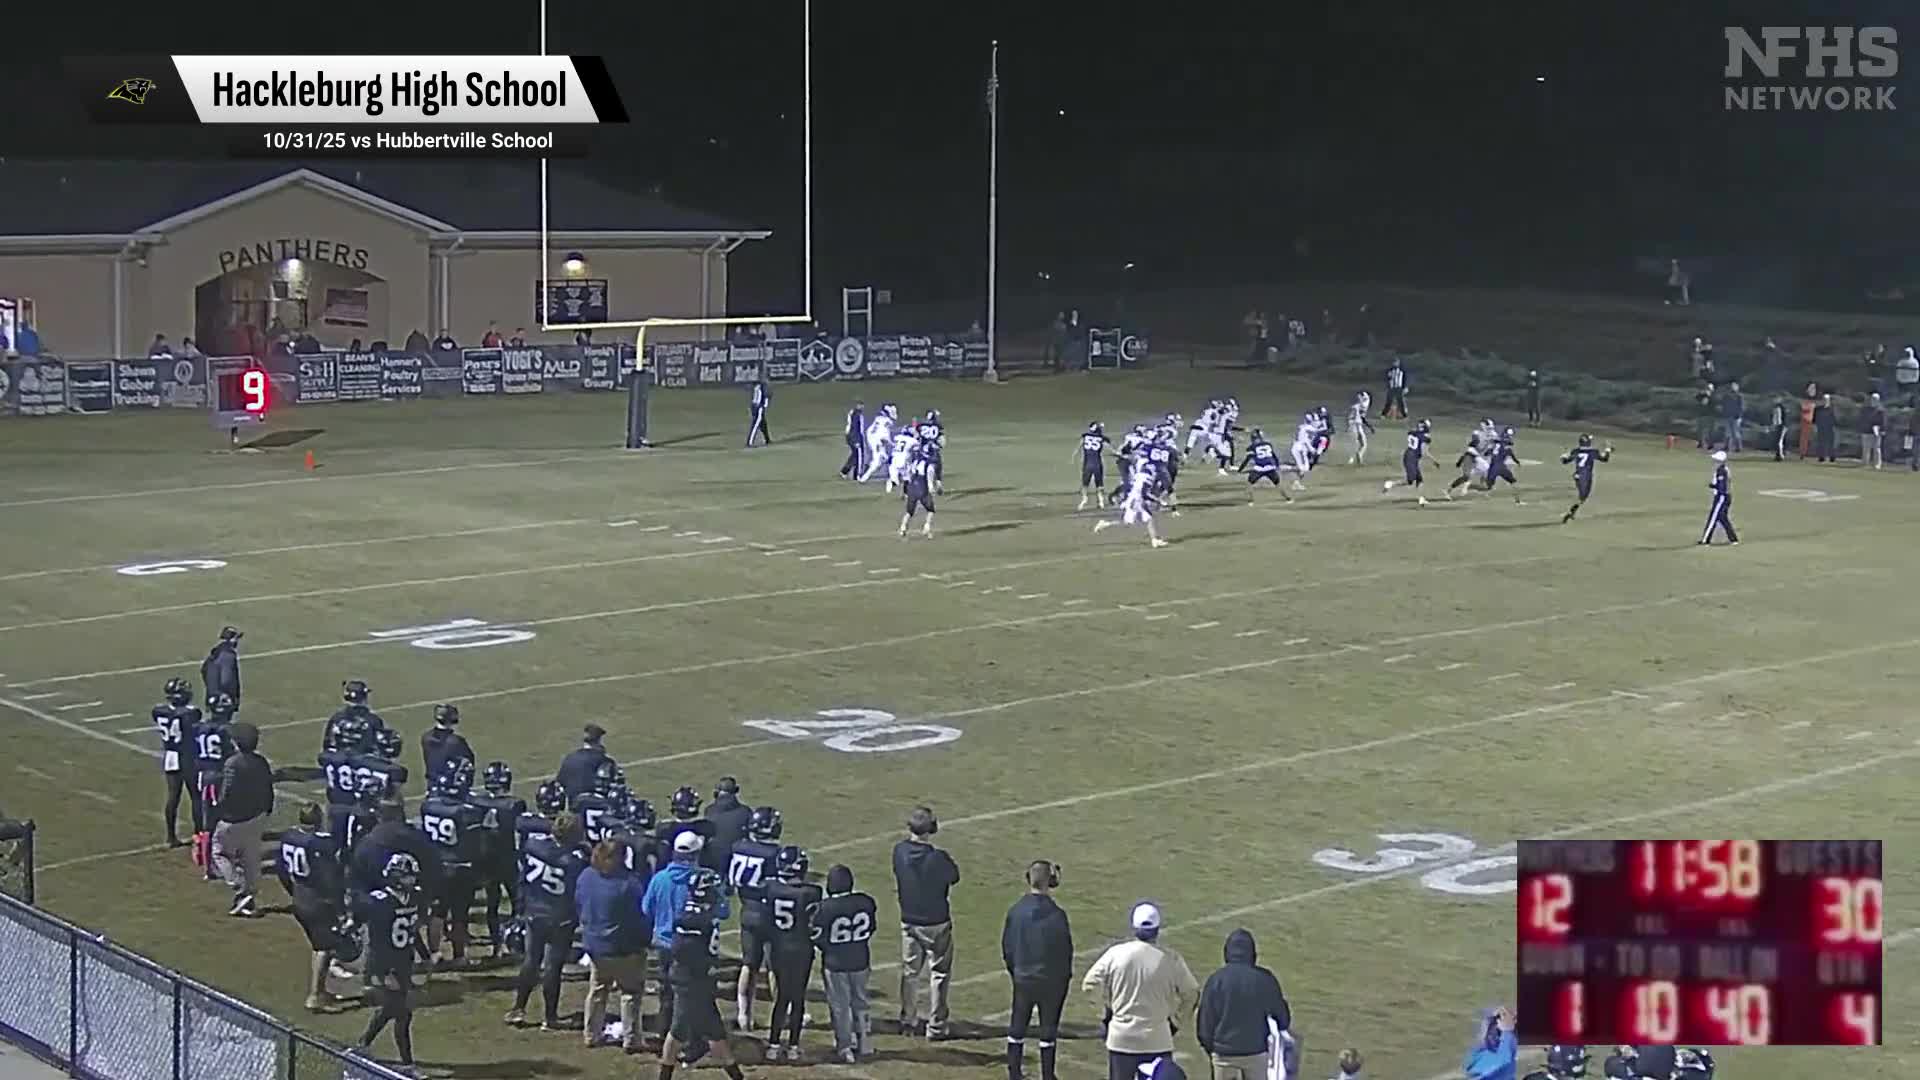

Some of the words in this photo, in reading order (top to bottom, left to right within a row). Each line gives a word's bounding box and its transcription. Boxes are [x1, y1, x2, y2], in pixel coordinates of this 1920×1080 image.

[219, 239, 369, 274] PANTHERS
[504, 350, 543, 370] YOGI'S
[243, 371, 264, 410] 9
[382, 384, 421, 394] Services
[383, 371, 419, 382] Poultry
[114, 393, 160, 408] Trucking
[368, 618, 537, 649] 10
[157, 717, 182, 743] 54
[742, 709, 962, 752] 20
[424, 814, 458, 845] 59
[282, 843, 311, 877] 50
[526, 854, 566, 895] 75
[774, 899, 795, 930] 5
[829, 911, 871, 943] 62
